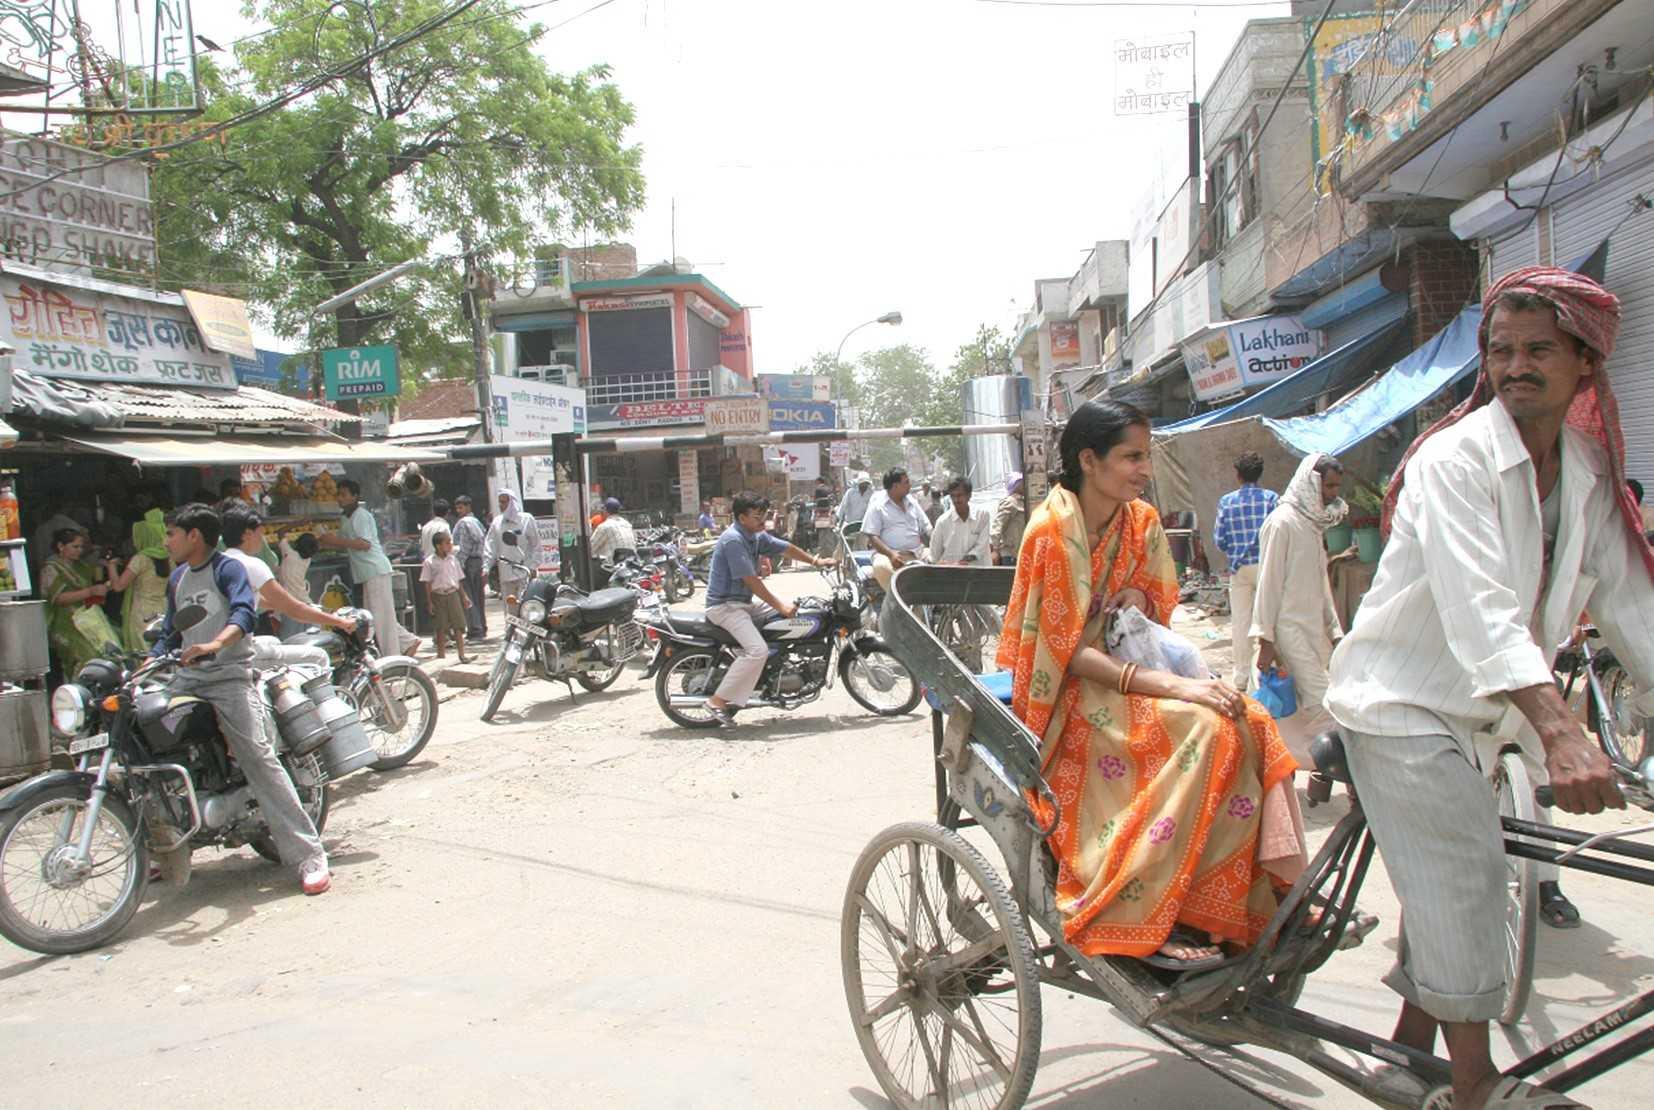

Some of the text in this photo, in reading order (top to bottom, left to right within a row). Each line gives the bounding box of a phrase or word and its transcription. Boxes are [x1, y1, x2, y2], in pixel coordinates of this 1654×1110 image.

[37, 186, 152, 234] CORNER
[1239, 327, 1310, 353] Lakhani
[338, 383, 385, 394] PREPAID
[711, 406, 726, 425] NO
[728, 407, 761, 425] ENTRY
[768, 407, 826, 423] OKIA
